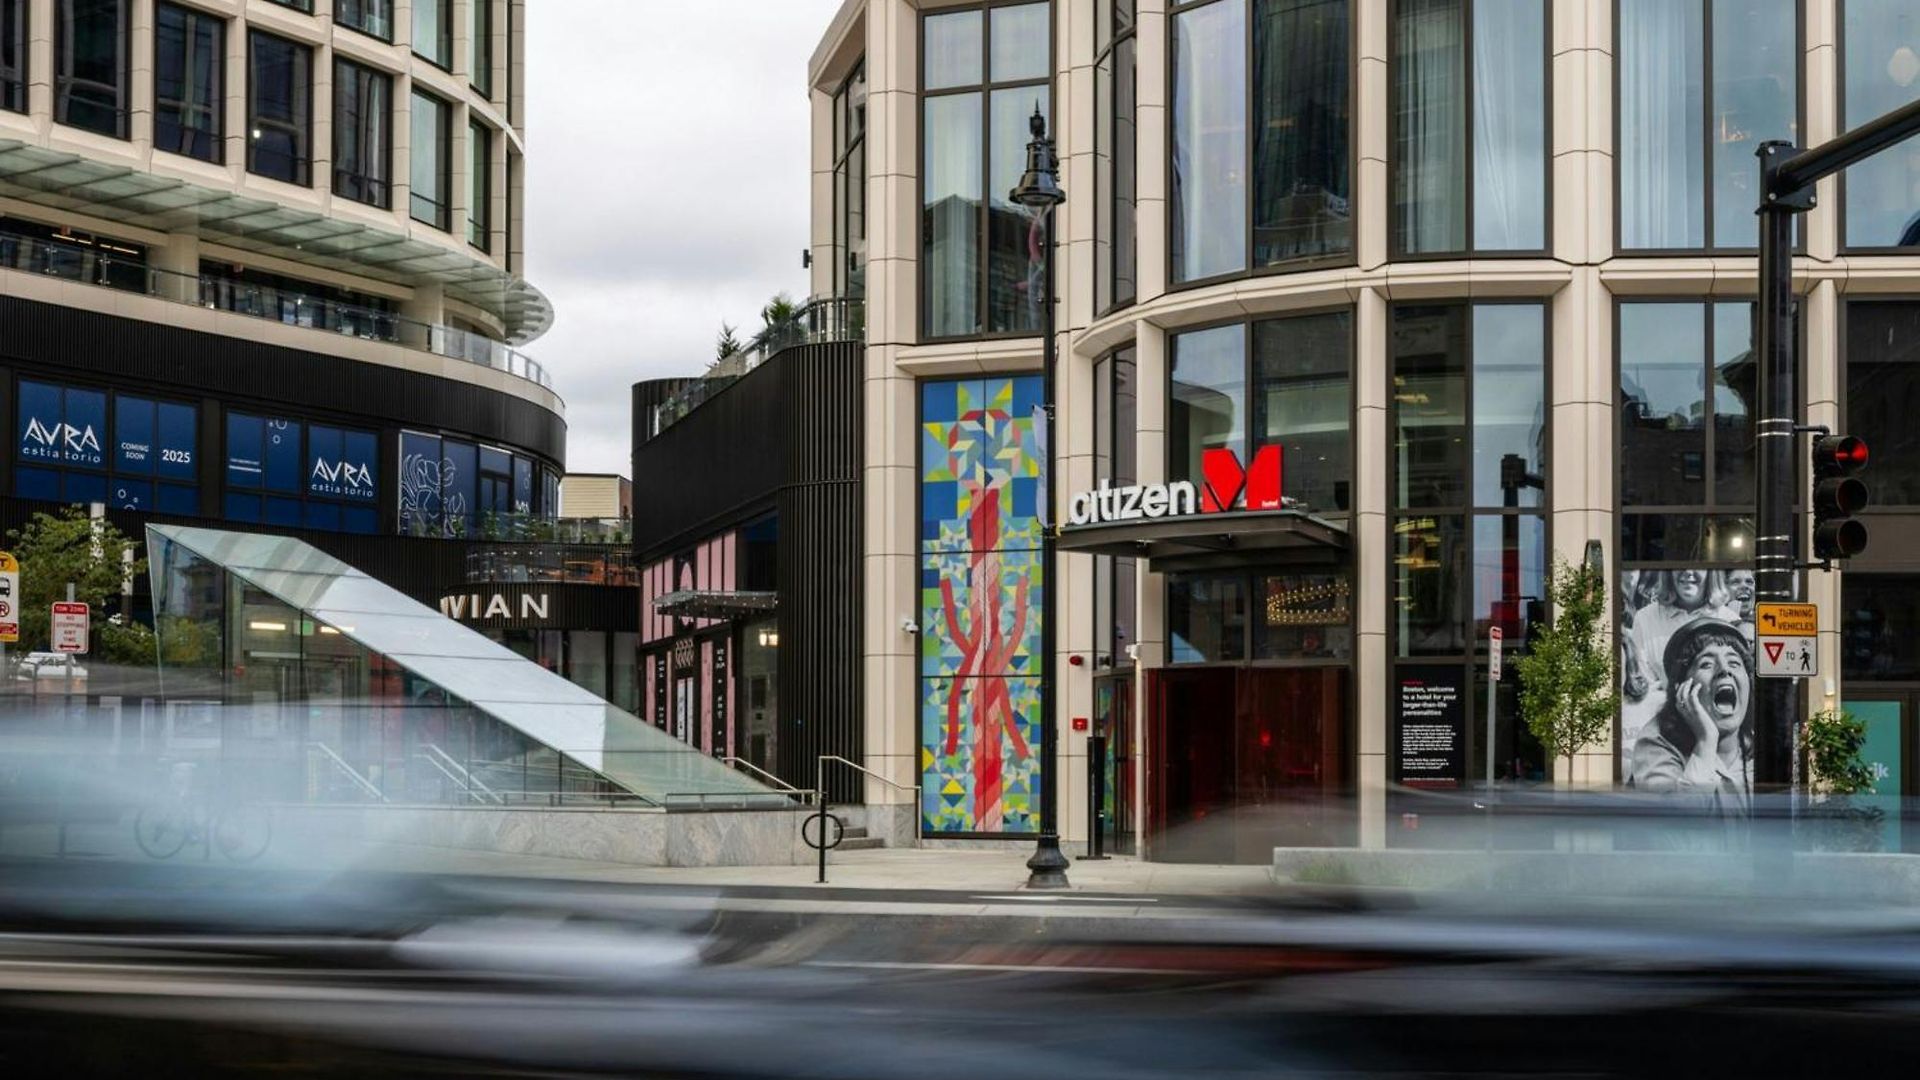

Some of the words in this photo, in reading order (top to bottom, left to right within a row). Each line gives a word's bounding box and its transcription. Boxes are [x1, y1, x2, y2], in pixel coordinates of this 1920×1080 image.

[23, 416, 101, 451] AVRA
[121, 442, 149, 452] COMING
[162, 449, 191, 463] 2025
[312, 456, 374, 487] AVRA
[1778, 608, 1813, 618] TURNING
[1777, 622, 1815, 632] VEHICLES
[1785, 651, 1796, 661] TO
